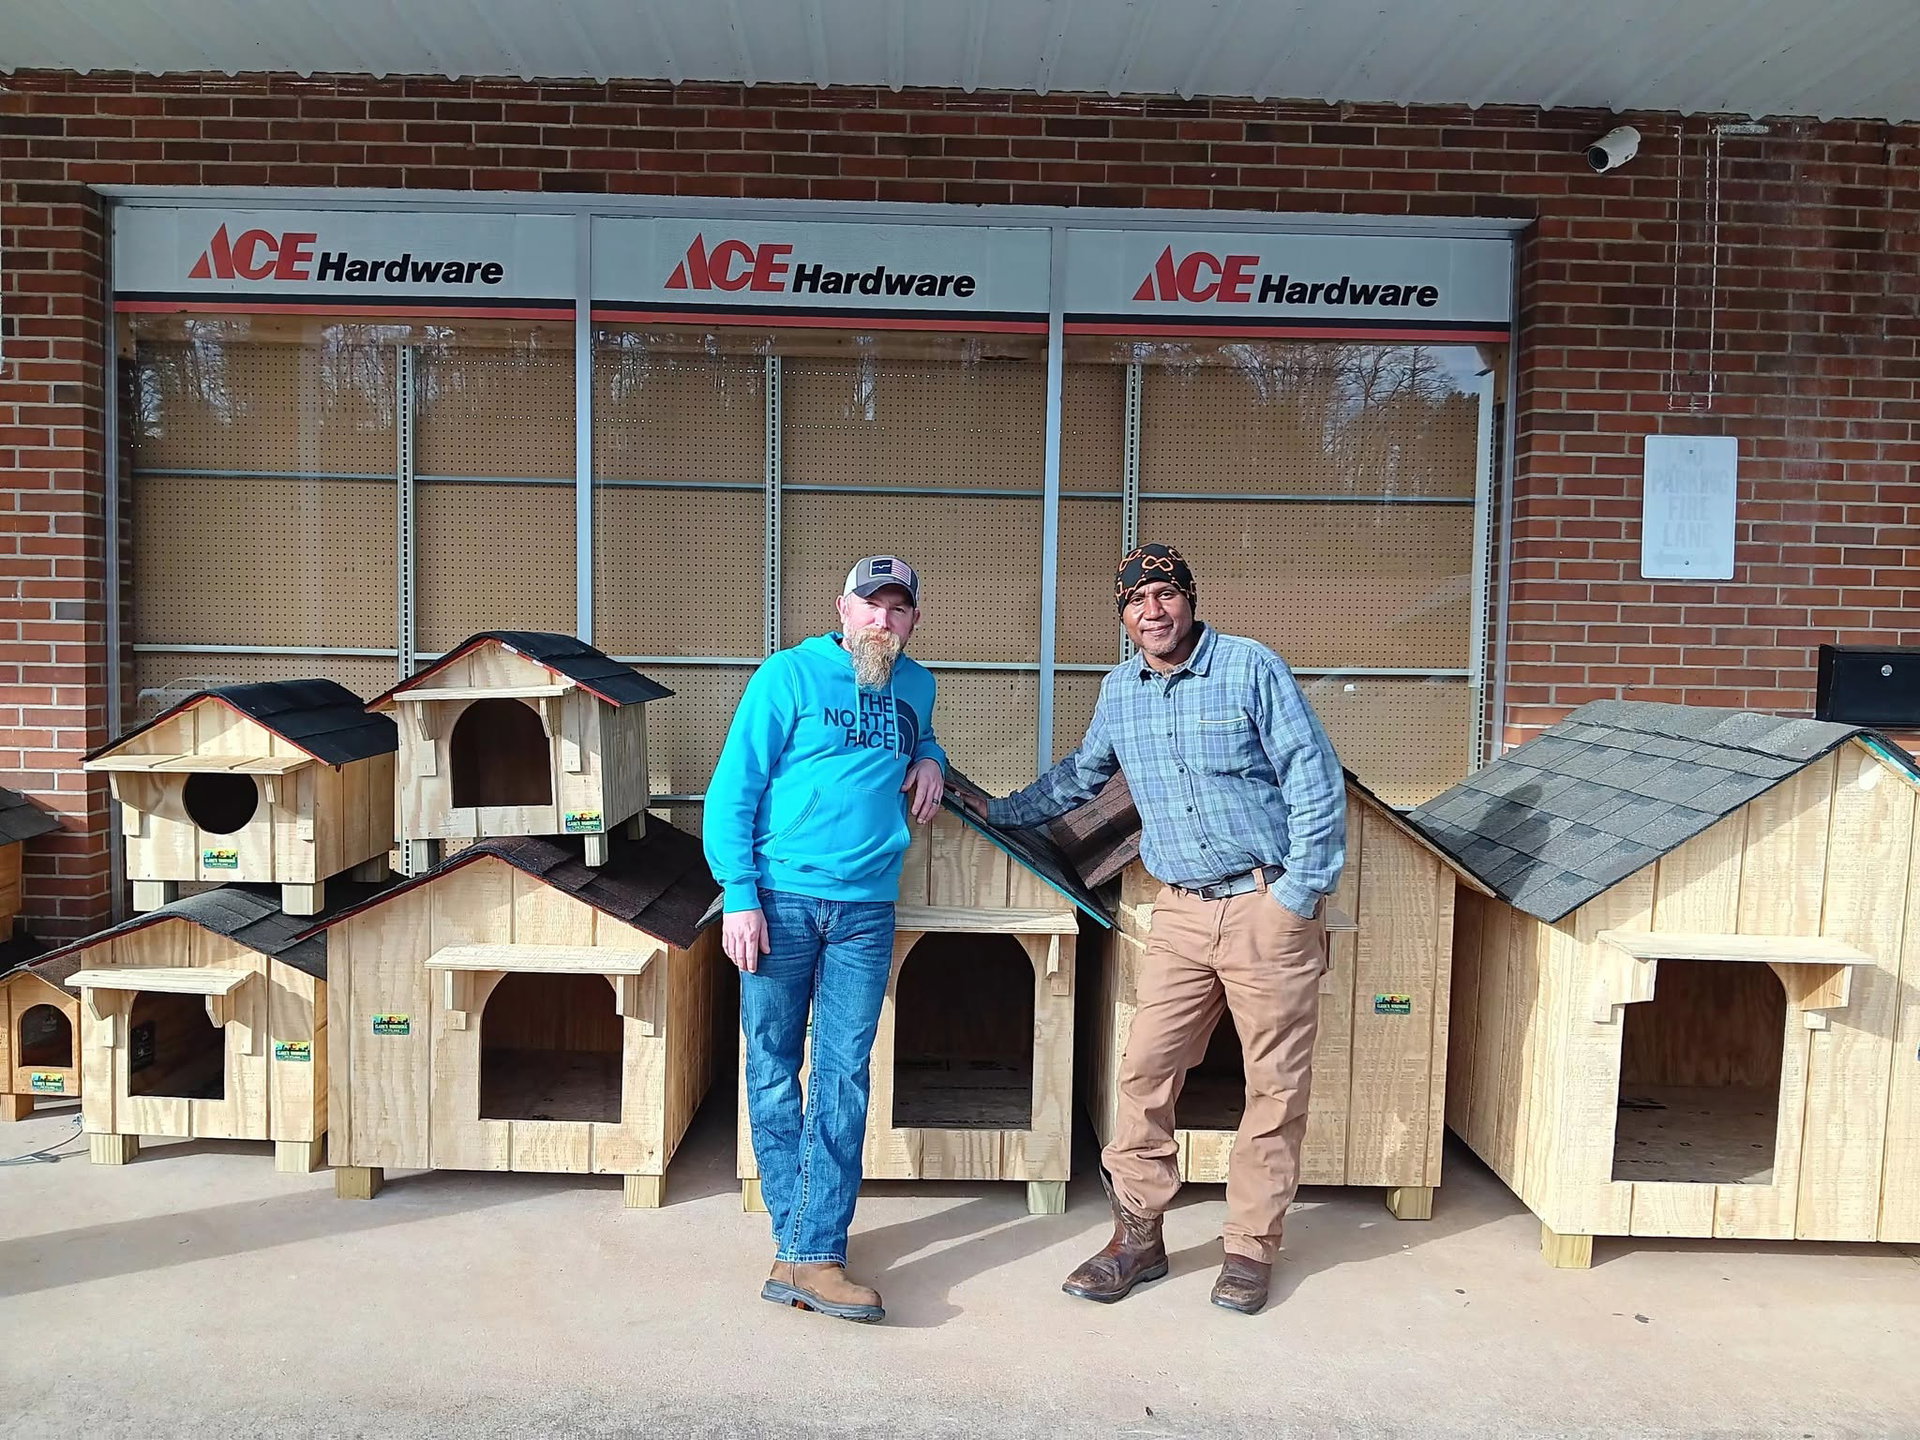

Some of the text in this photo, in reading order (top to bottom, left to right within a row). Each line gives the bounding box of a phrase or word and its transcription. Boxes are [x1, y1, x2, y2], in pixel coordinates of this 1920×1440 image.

[188, 222, 504, 285] ACE Hardware
[664, 232, 976, 298] ACE Hardware
[1132, 244, 1439, 307] ACE Hardware
[1668, 495, 1711, 521] FIRE
[1663, 522, 1713, 548] LANE
[859, 692, 893, 713] THE
[824, 707, 896, 731] NORTH
[844, 728, 896, 750] FACE
